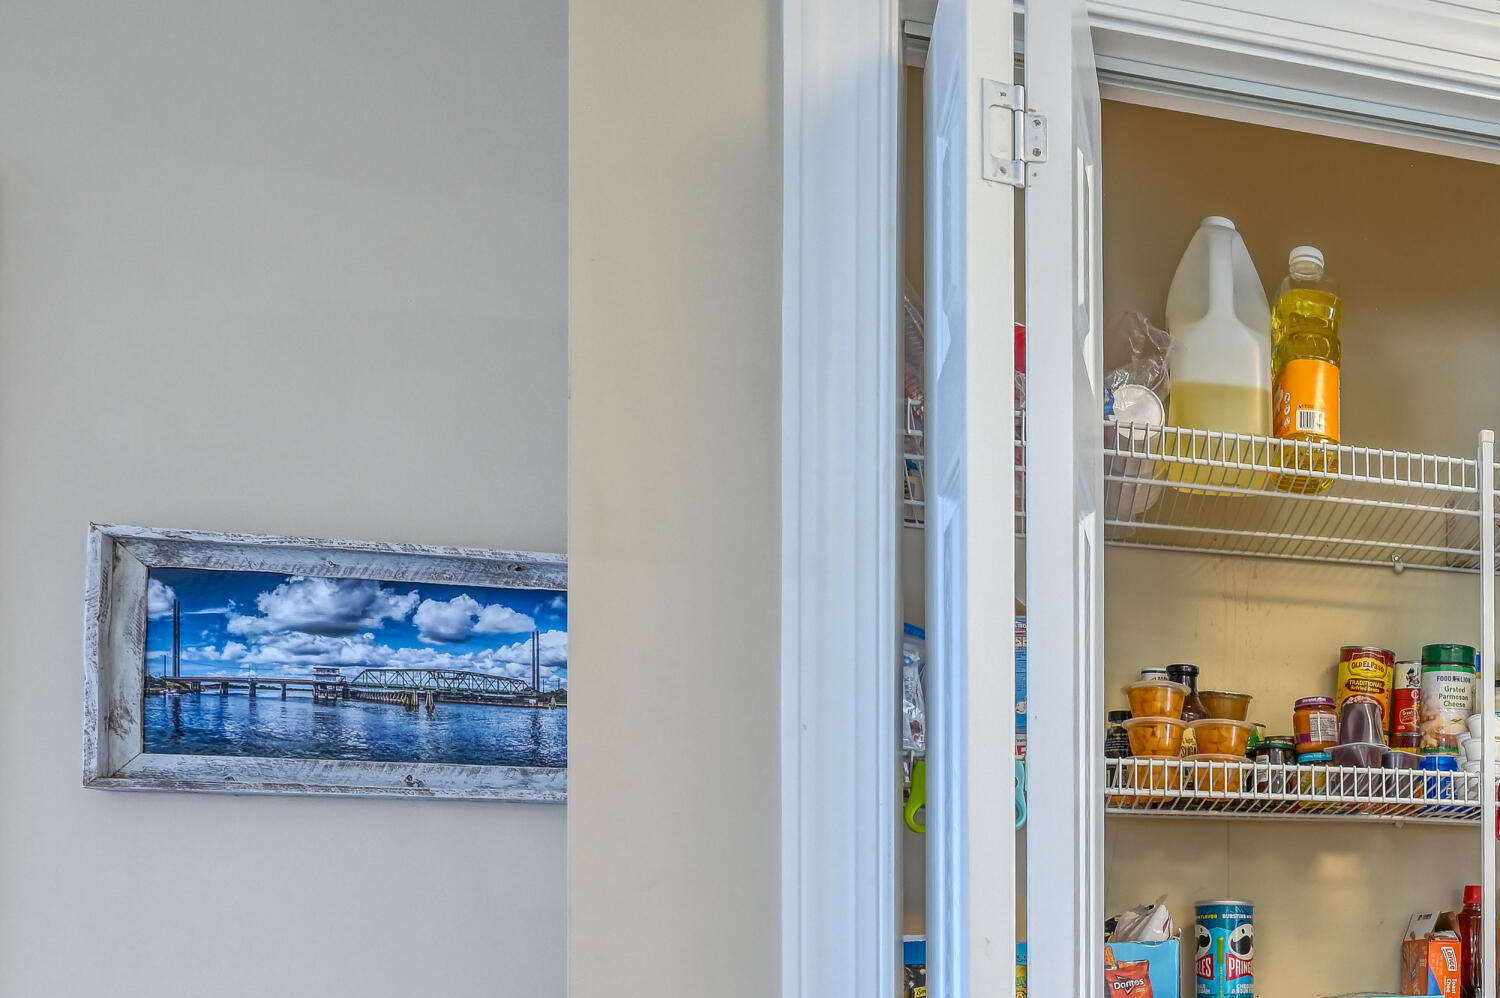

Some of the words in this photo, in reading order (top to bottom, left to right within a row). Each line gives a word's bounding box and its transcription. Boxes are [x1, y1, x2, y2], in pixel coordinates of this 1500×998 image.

[1351, 662, 1362, 670] OLD
[1348, 679, 1383, 688] TRADITIONAL
[1438, 692, 1469, 700] Parmesan
[1181, 746, 1198, 757] SUGA
[1445, 948, 1456, 970] Lance
[1228, 958, 1253, 978] PRING
[1114, 978, 1144, 990] Doritos
